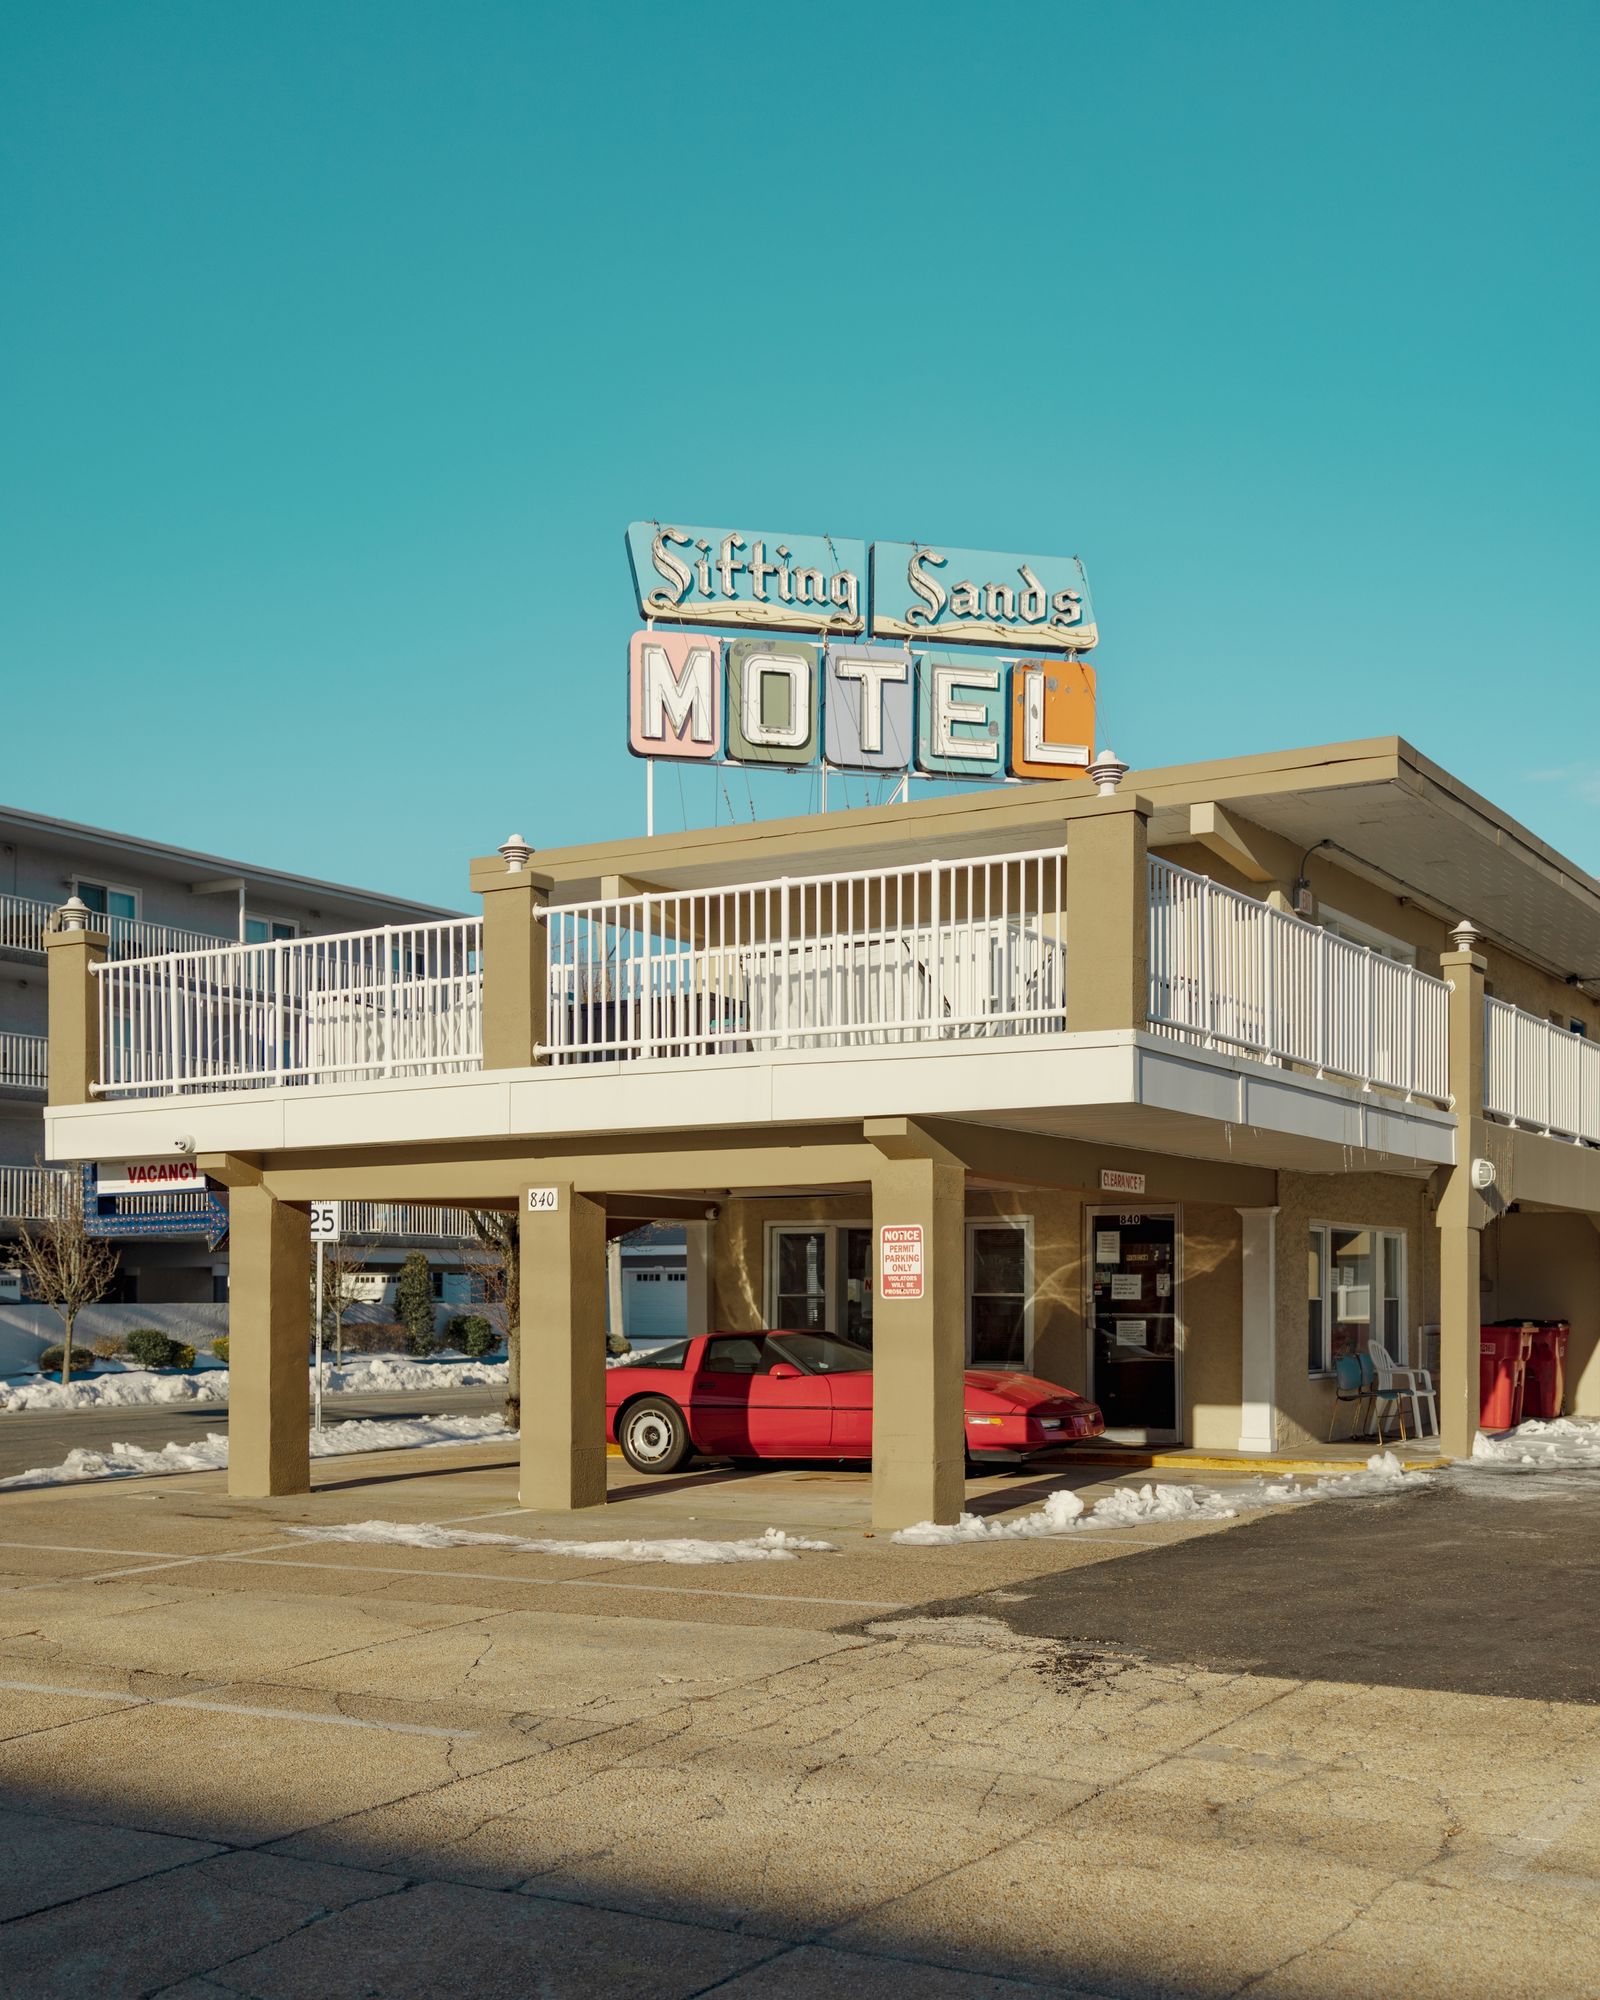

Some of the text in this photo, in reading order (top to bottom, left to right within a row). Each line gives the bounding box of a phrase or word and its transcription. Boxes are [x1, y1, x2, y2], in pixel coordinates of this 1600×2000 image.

[648, 527, 1083, 628] Sifting Sands
[641, 643, 1090, 766] MOTEL
[127, 1162, 199, 1184] VACANCY
[1103, 1171, 1138, 1190] CLEARANCE
[530, 1191, 554, 1207] 840
[310, 1209, 335, 1232] 25
[1120, 1214, 1140, 1224] 840
[884, 1230, 920, 1241] NOTICE
[889, 1244, 915, 1253] PERMIT
[885, 1254, 920, 1263] PARKING
[892, 1263, 912, 1272] ONLY
